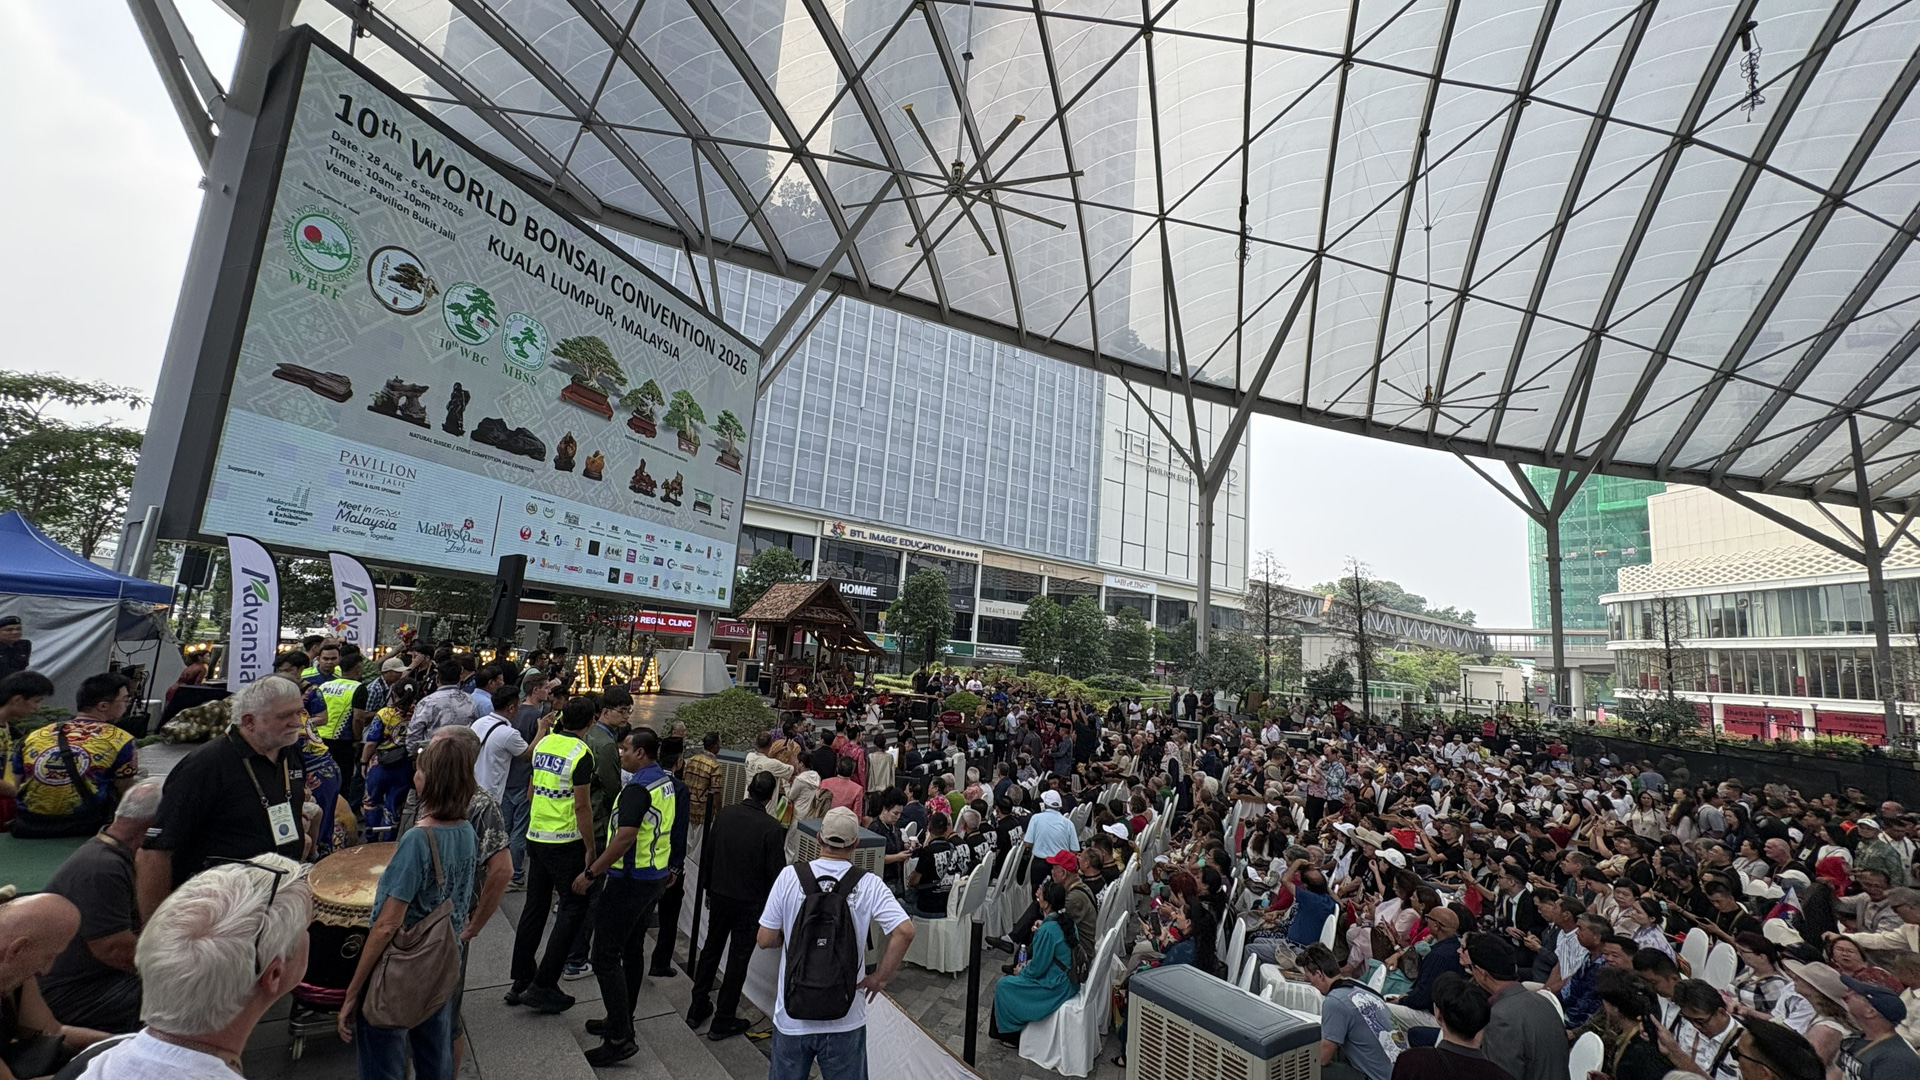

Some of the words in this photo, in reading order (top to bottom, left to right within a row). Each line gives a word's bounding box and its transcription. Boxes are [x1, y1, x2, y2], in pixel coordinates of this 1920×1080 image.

[329, 145, 356, 167] Time
[366, 167, 394, 190] 10am
[403, 190, 431, 212] 10pm
[331, 130, 358, 153] Date
[367, 152, 380, 166] 28
[382, 162, 403, 182] Aug
[411, 179, 418, 189] 6
[419, 184, 441, 203] Sept
[442, 198, 464, 217] 2026
[325, 160, 361, 186] Venue
[369, 186, 410, 215] Pavilion
[412, 209, 437, 231] Bukit
[438, 225, 456, 241] Jalil
[294, 204, 330, 217] WORLD
[331, 211, 358, 247] BONSAI
[334, 94, 402, 144] 10th
[412, 138, 517, 227] WORLD
[524, 215, 606, 286] BONSAI
[611, 275, 716, 355] CONVENTION
[718, 344, 748, 375] 2026
[283, 218, 315, 276] FRIENDSHIP
[315, 254, 363, 283] FEDERATION
[488, 234, 545, 283] KUALA
[550, 272, 617, 327] LUMPUR,
[621, 315, 680, 361] MALAYSIA
[440, 338, 459, 351] 10th
[460, 346, 489, 367] WBC
[502, 363, 537, 387] MBSS
[409, 431, 433, 444] NATURAL
[455, 446, 471, 455] STONE
[471, 450, 501, 463] COMPETITION
[1115, 427, 1160, 460] THE
[227, 464, 257, 476] Supported
[257, 470, 265, 478] by
[339, 450, 417, 480] PAVILION
[345, 468, 374, 480] BUKIT
[382, 477, 406, 488] JALIL
[348, 479, 363, 488] VENUE
[381, 487, 401, 495] SPONSOR
[266, 496, 298, 508] Malaysia
[276, 505, 313, 517] Convention
[337, 500, 363, 511] Meet
[363, 504, 372, 514] in
[275, 511, 308, 522] Exhibition
[335, 509, 398, 531] Malaysia
[332, 524, 341, 533] BE
[342, 526, 368, 538] Greater,
[416, 520, 471, 543] Malaysia
[850, 529, 867, 539] BTL
[869, 532, 897, 544] IMAGE
[900, 538, 946, 553] EDUCATION
[445, 540, 466, 554] Truly
[466, 547, 482, 555] Asia
[839, 583, 878, 597] HOMME
[342, 581, 368, 646] Adva
[640, 616, 666, 626] REGAL
[668, 618, 693, 628] CLINIC
[240, 567, 271, 684] Advansia
[729, 625, 745, 634] BJS
[570, 654, 661, 694] AYSIA
[322, 686, 343, 696] POLIS
[535, 753, 562, 771] POLIS
